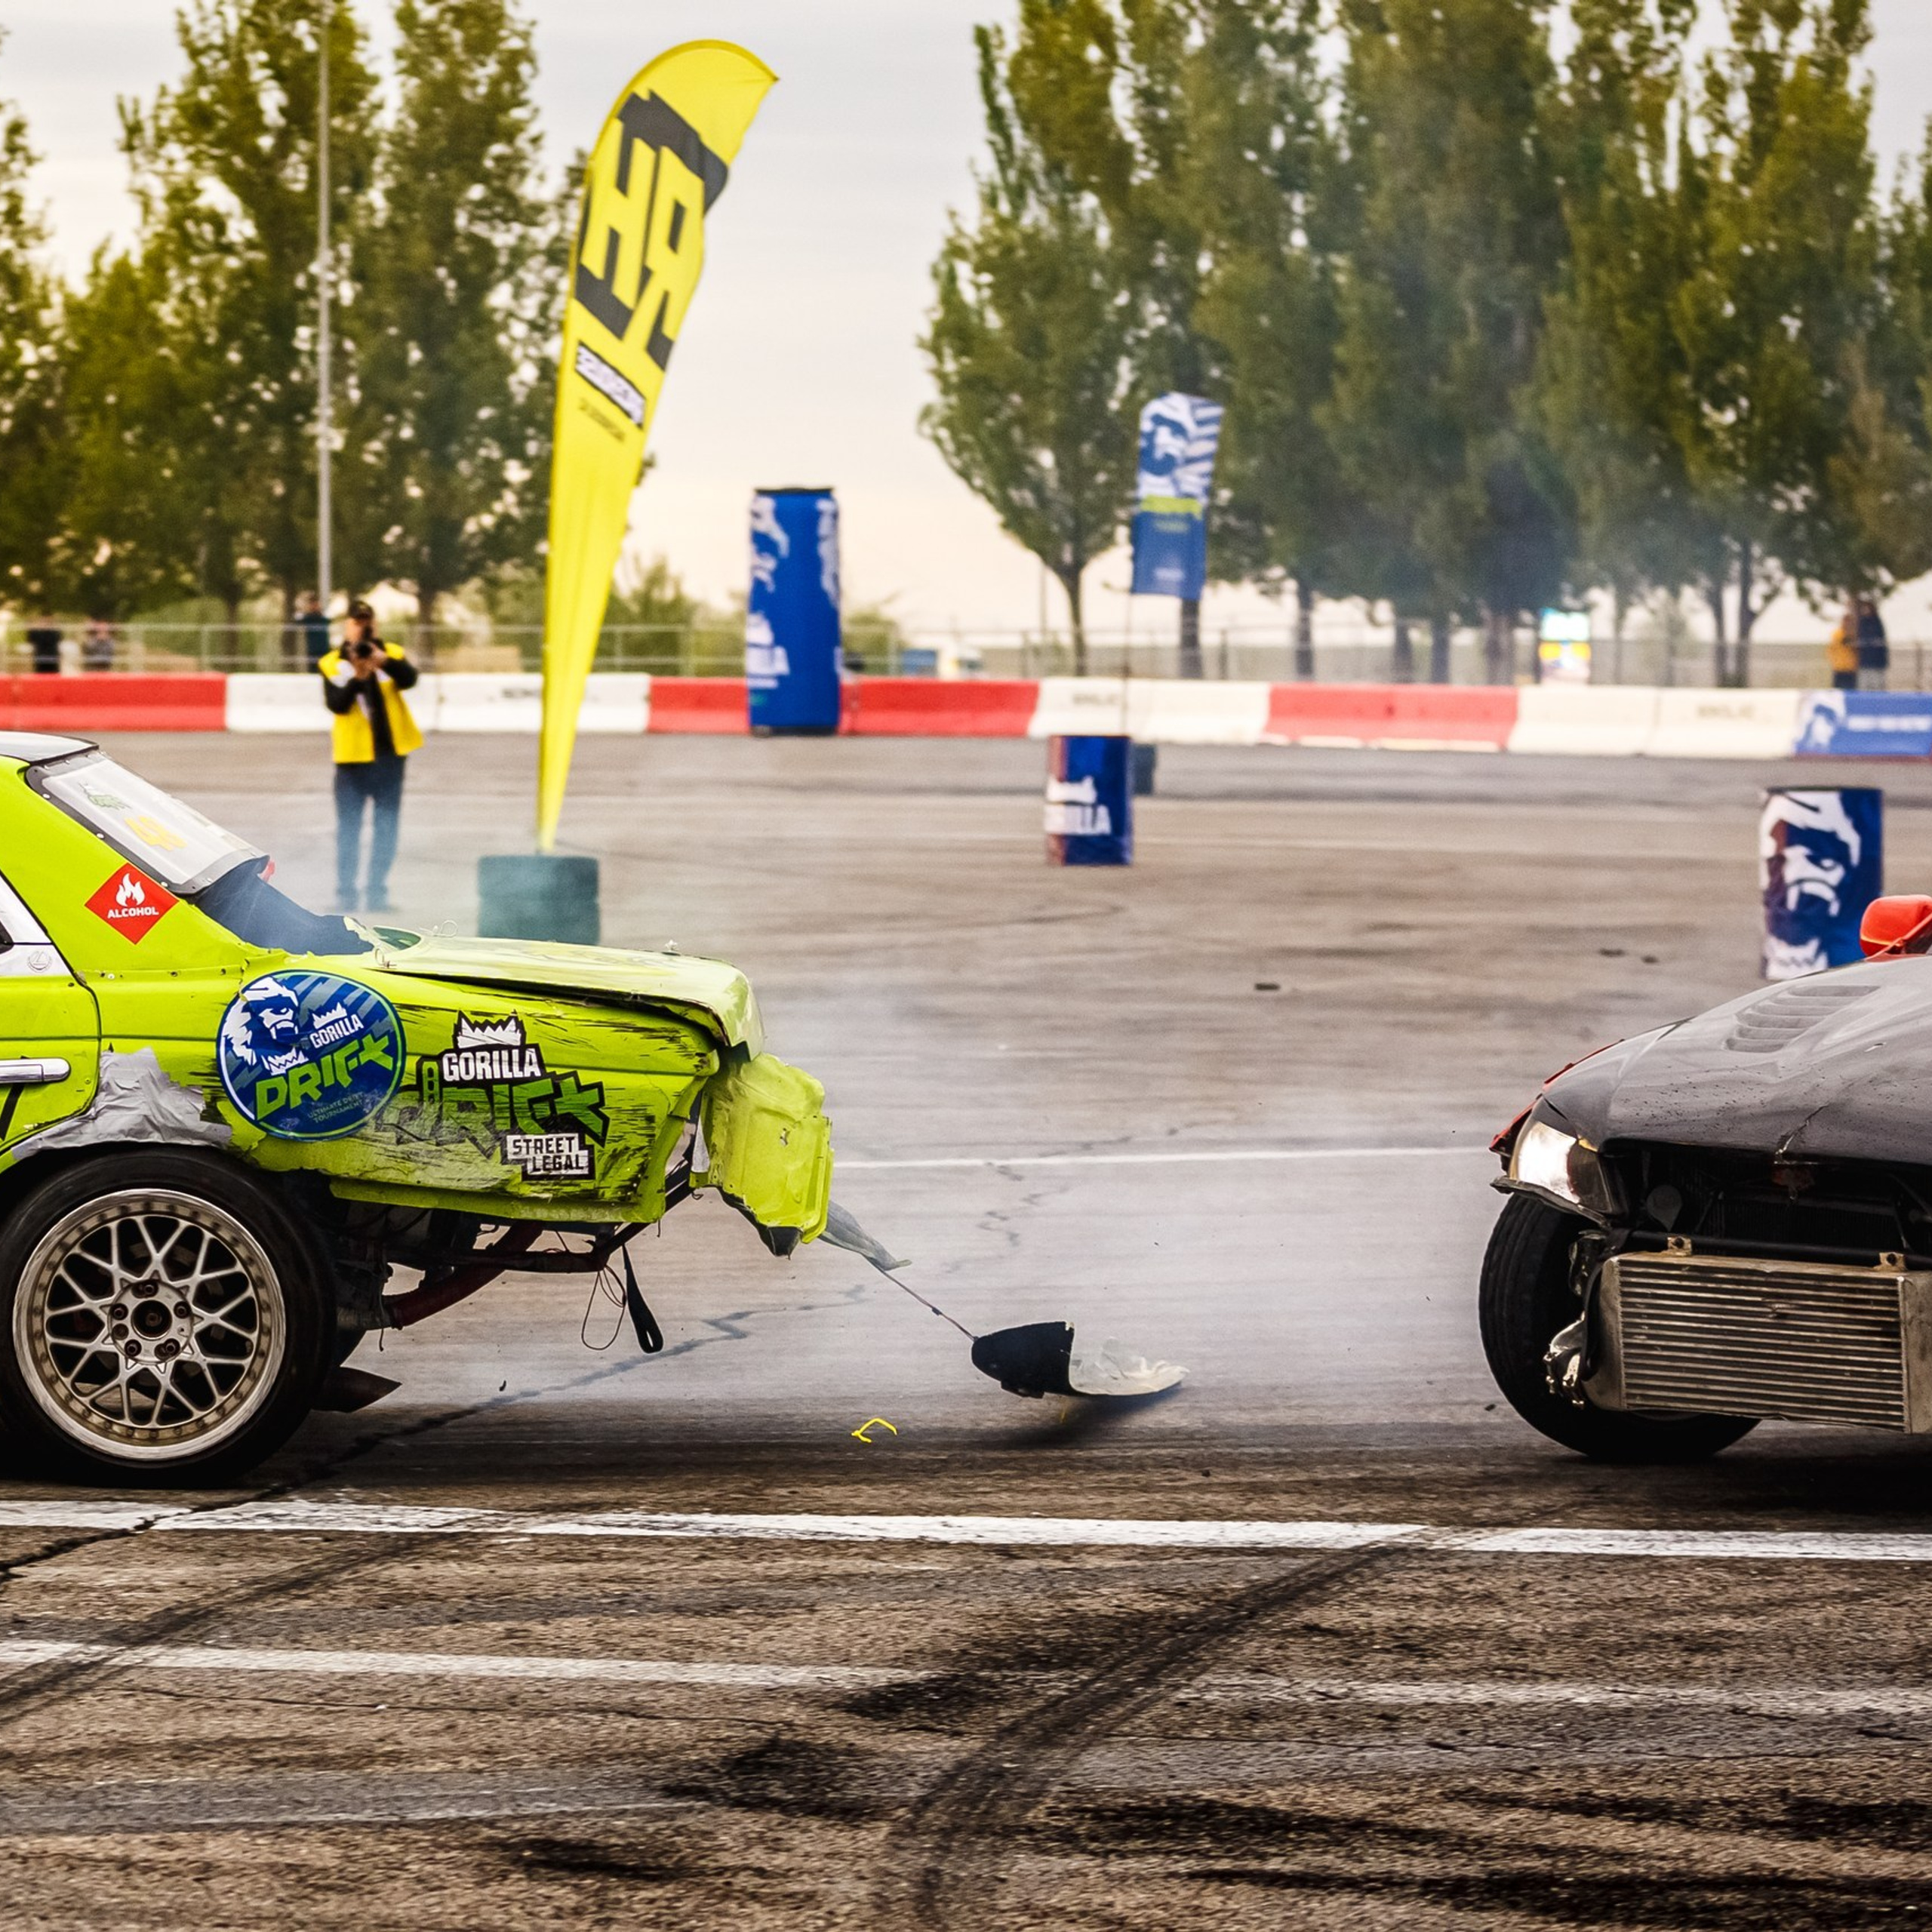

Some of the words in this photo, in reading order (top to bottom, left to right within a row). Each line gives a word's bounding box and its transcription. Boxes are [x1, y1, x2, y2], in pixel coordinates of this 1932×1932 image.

[107, 906, 159, 918] ALCOHOL
[309, 1014, 364, 1048] GORILLA
[442, 1048, 542, 1081] GORILLA
[513, 1137, 575, 1155] STREET
[531, 1154, 584, 1173] LEGAL
